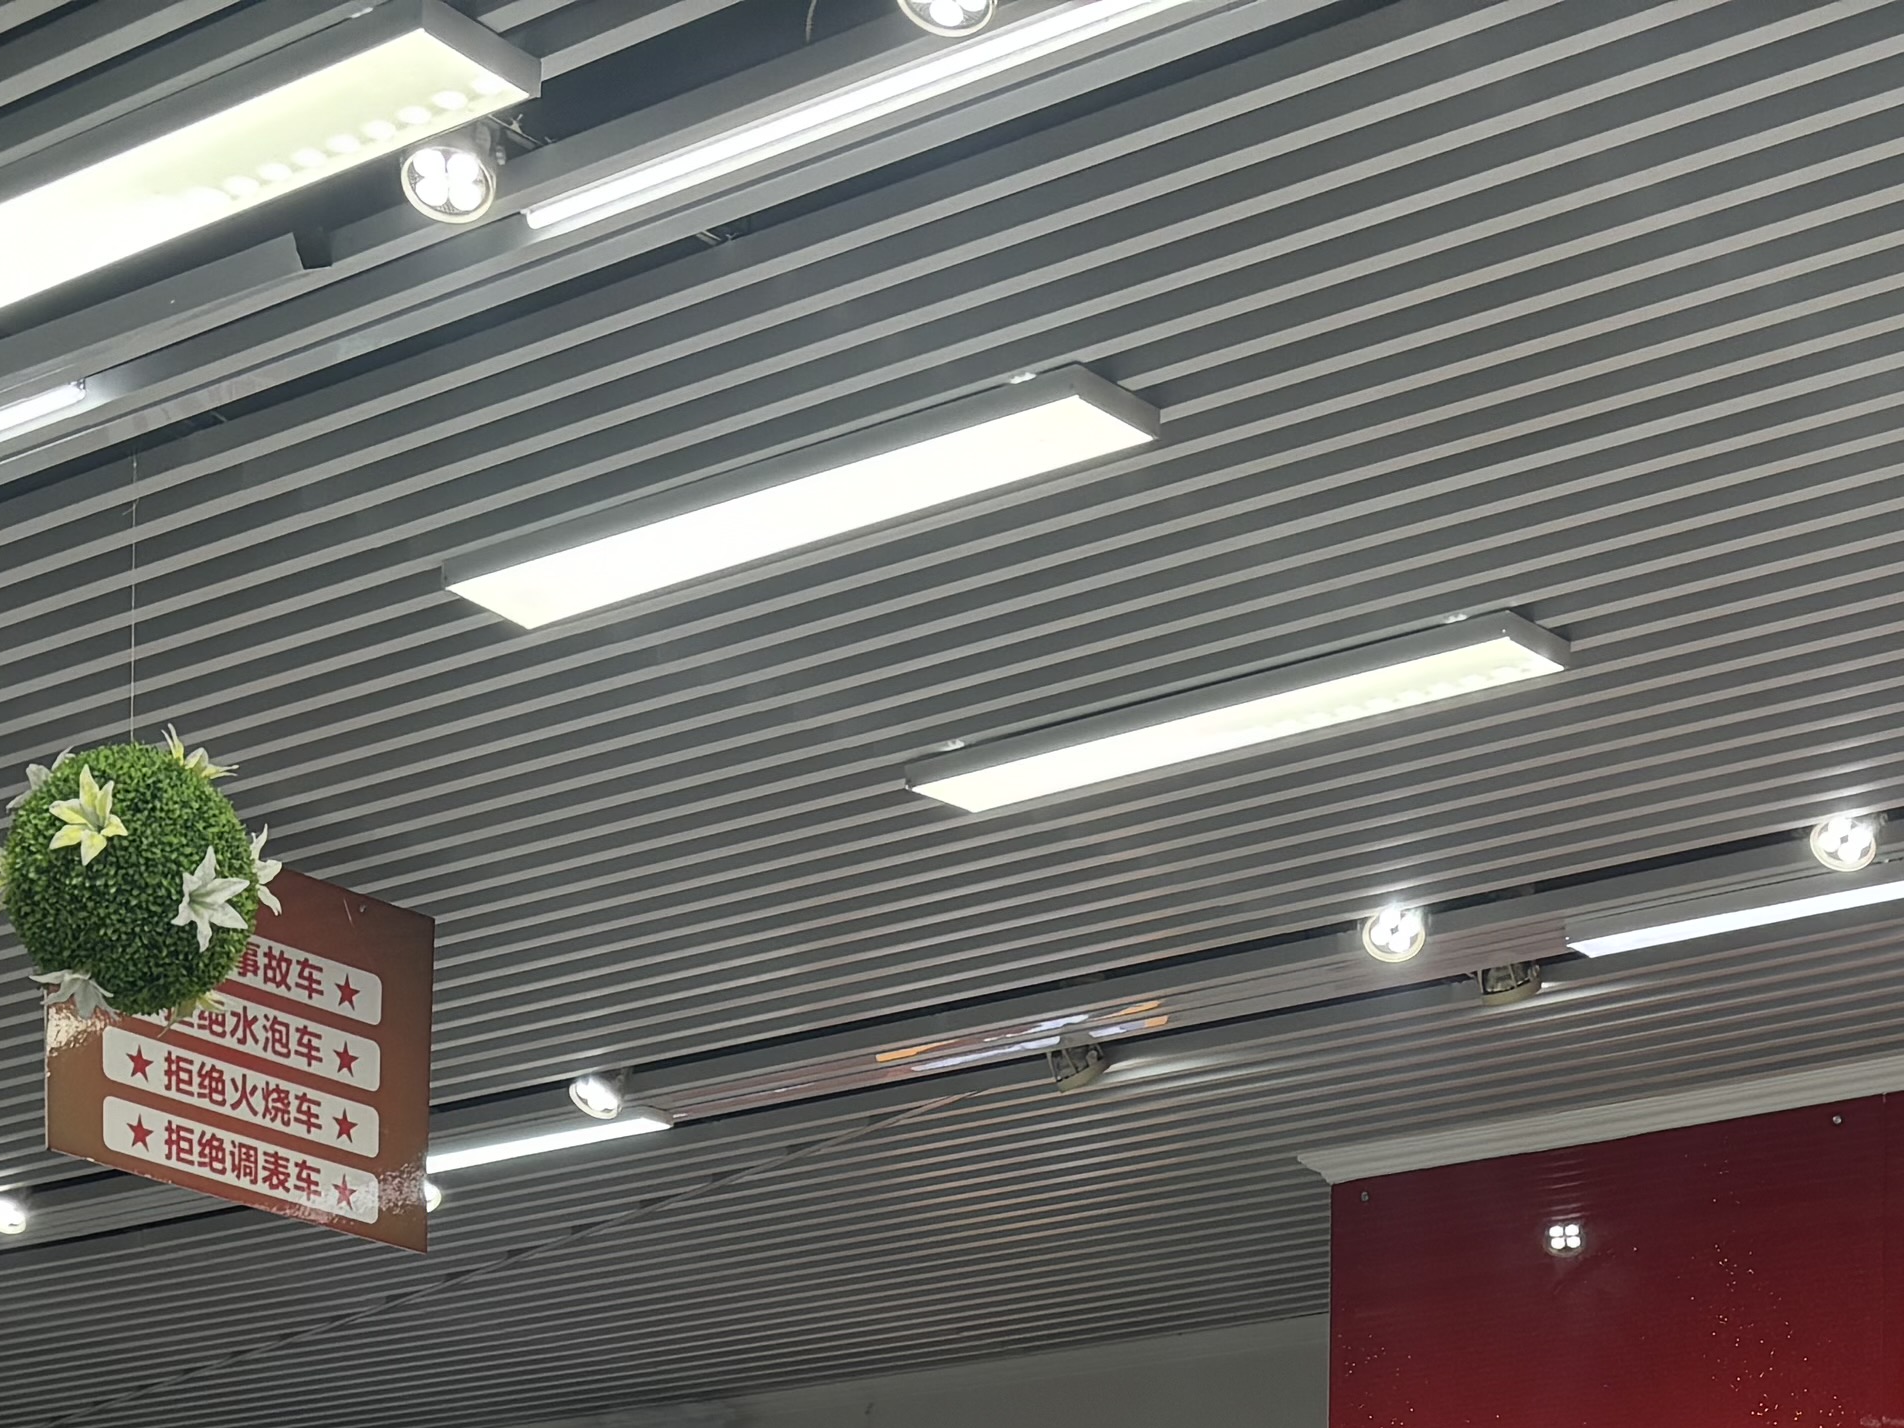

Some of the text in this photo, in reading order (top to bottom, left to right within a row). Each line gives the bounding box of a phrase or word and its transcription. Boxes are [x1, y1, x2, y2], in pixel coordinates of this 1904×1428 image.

[164, 1051, 323, 1135] 拒绝火烧车
[164, 1119, 322, 1200] 拒绝调表车
